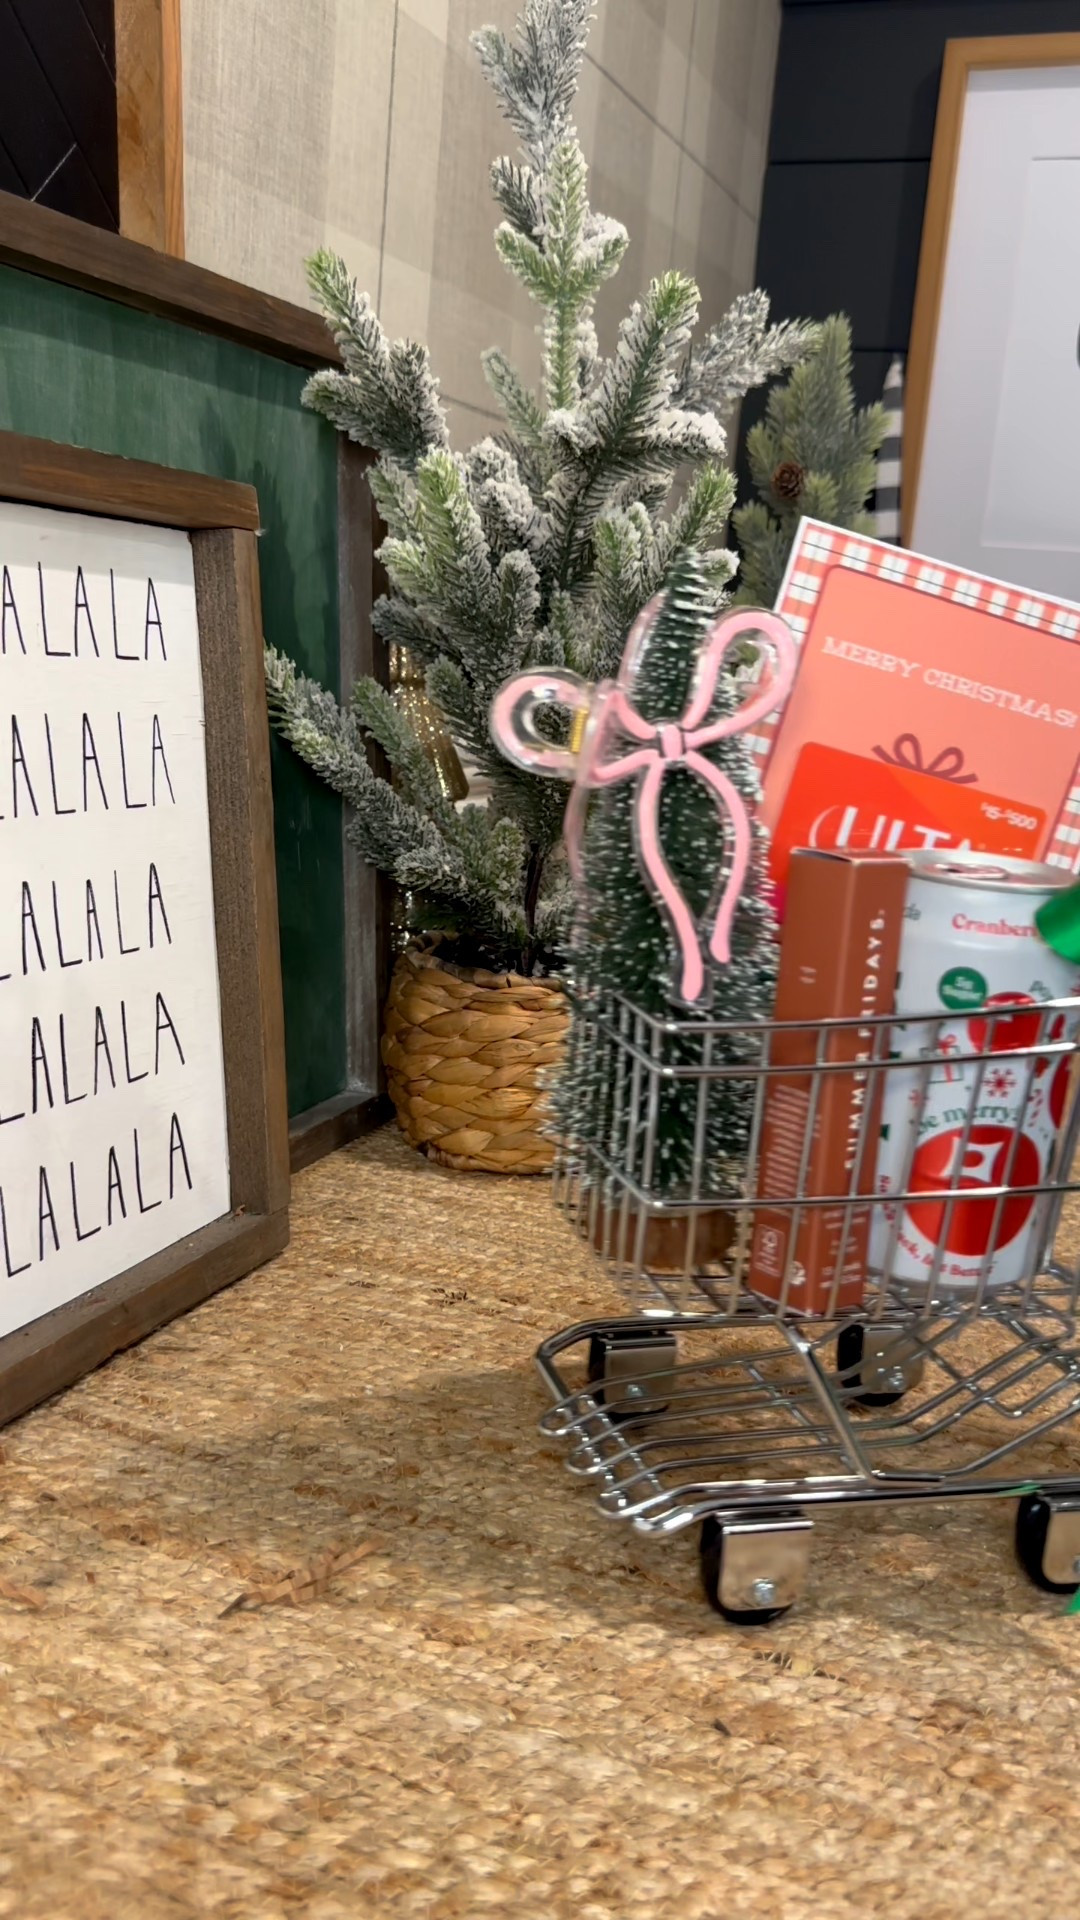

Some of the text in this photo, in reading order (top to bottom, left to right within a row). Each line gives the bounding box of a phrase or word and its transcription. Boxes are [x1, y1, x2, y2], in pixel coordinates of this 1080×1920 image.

[821, 636, 1079, 728] MERRY CHRISTMAS!
[0, 711, 176, 820] ALALA
[834, 806, 972, 851] ULT
[0, 862, 172, 980] ALALA
[952, 912, 1039, 938] Cranberr
